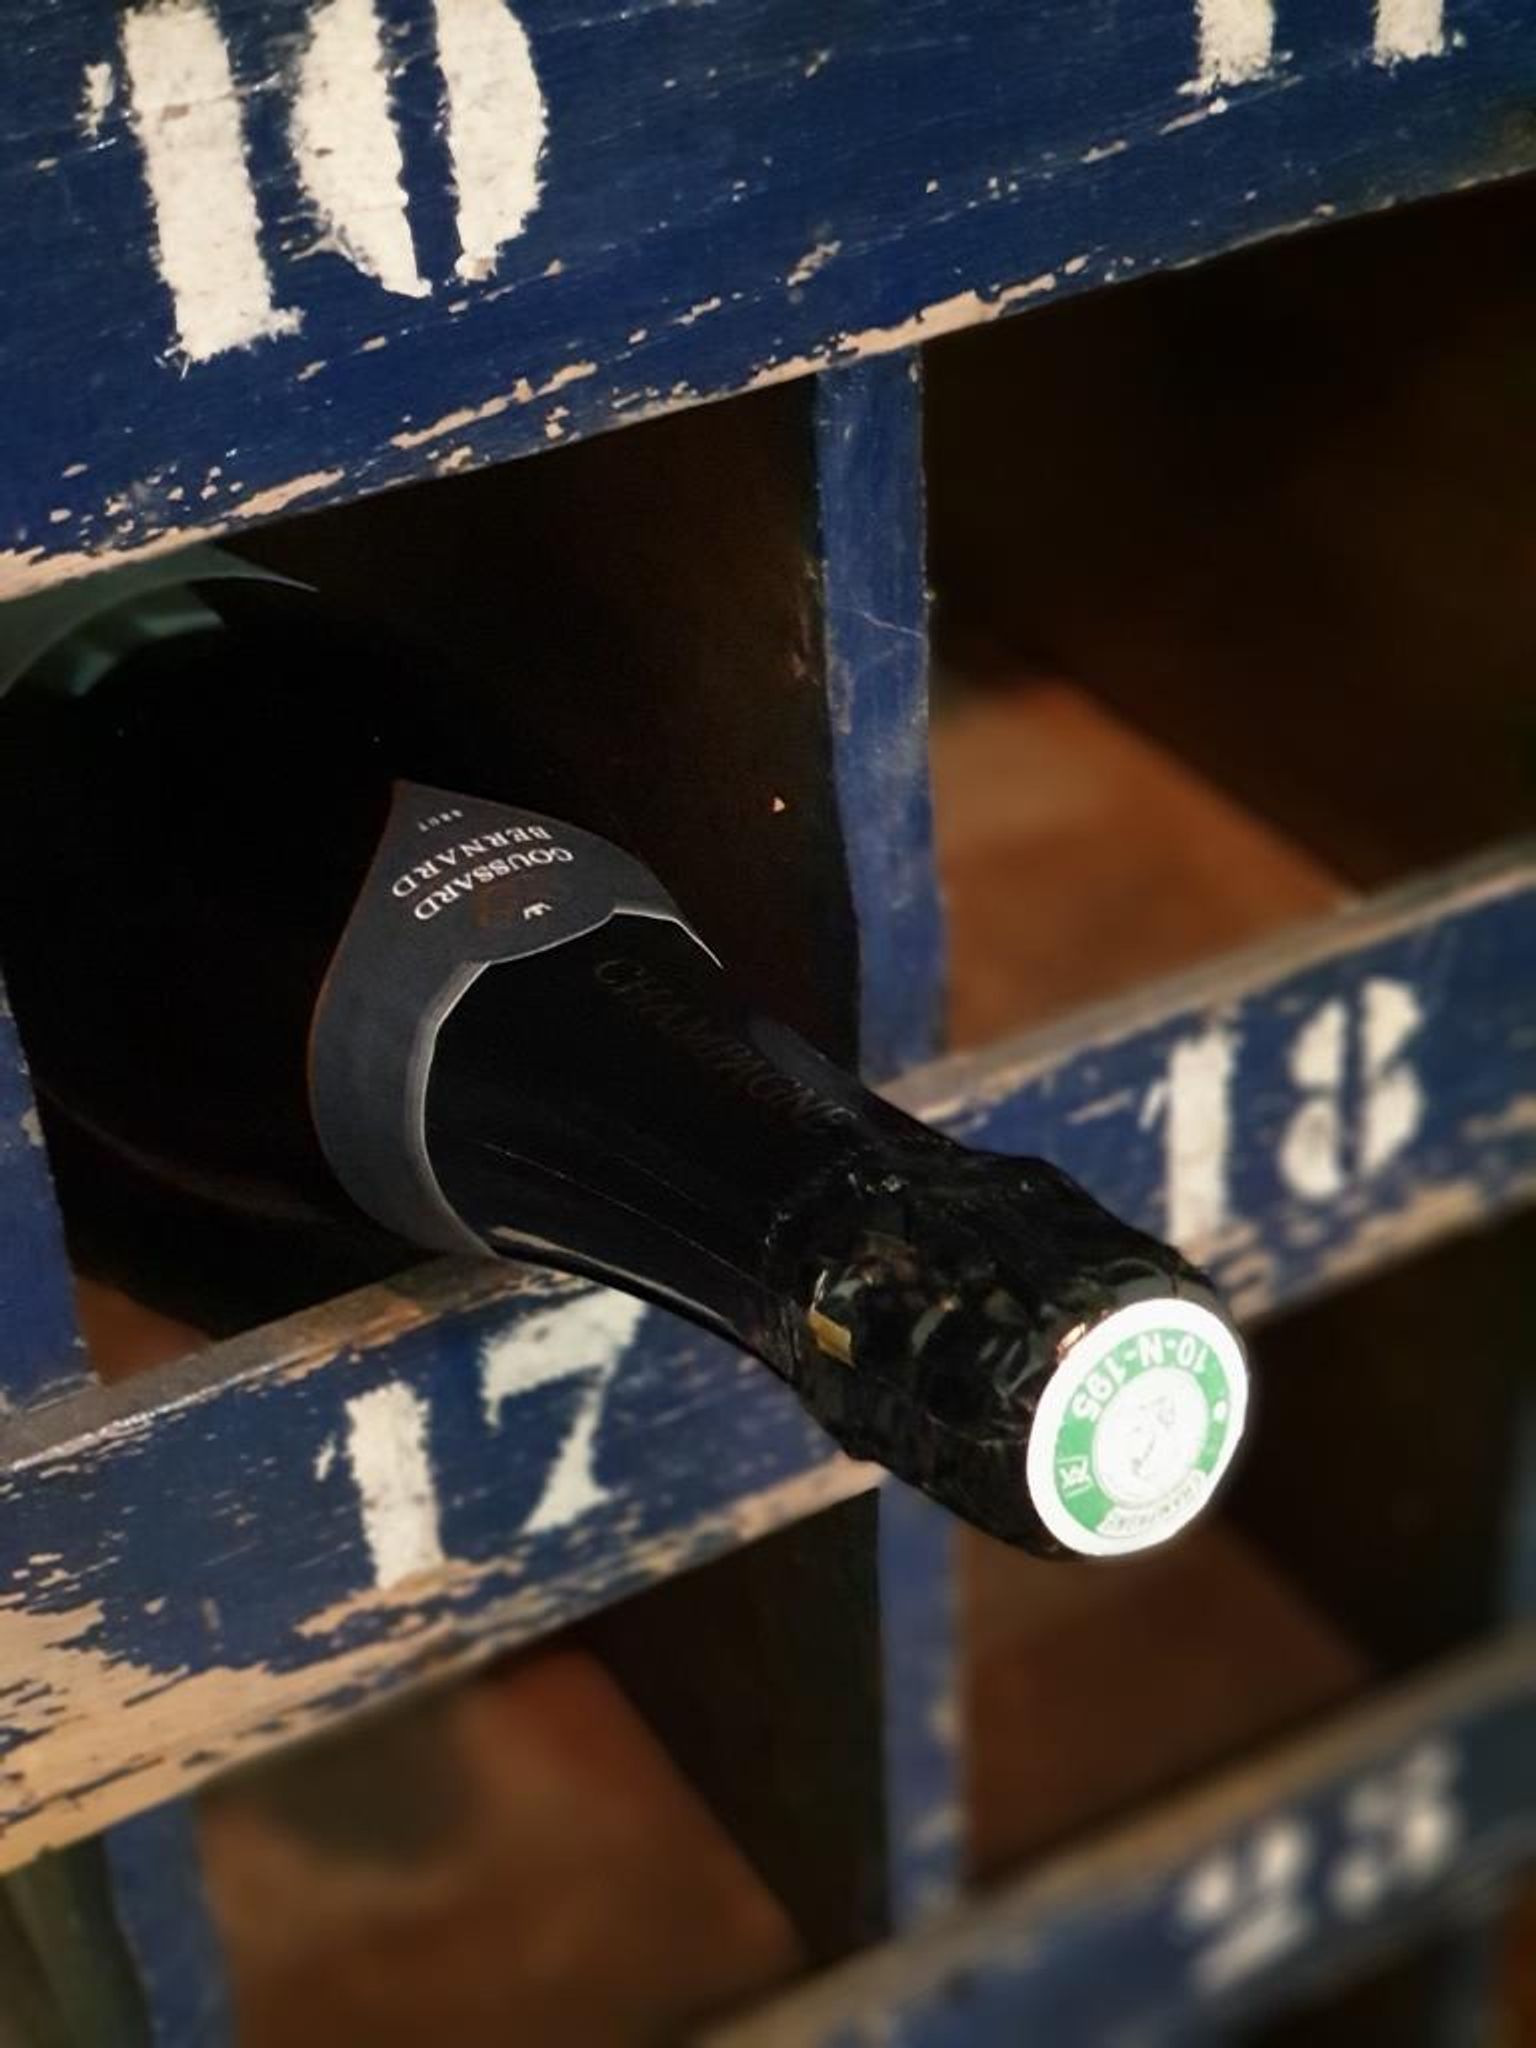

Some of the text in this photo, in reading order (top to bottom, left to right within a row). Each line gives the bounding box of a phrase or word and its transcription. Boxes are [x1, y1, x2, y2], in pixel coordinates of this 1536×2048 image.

[78, 0, 550, 368] 10
[391, 825, 554, 898] BERNARD
[1138, 978, 1424, 1248] 18
[314, 1290, 648, 1590] 17
